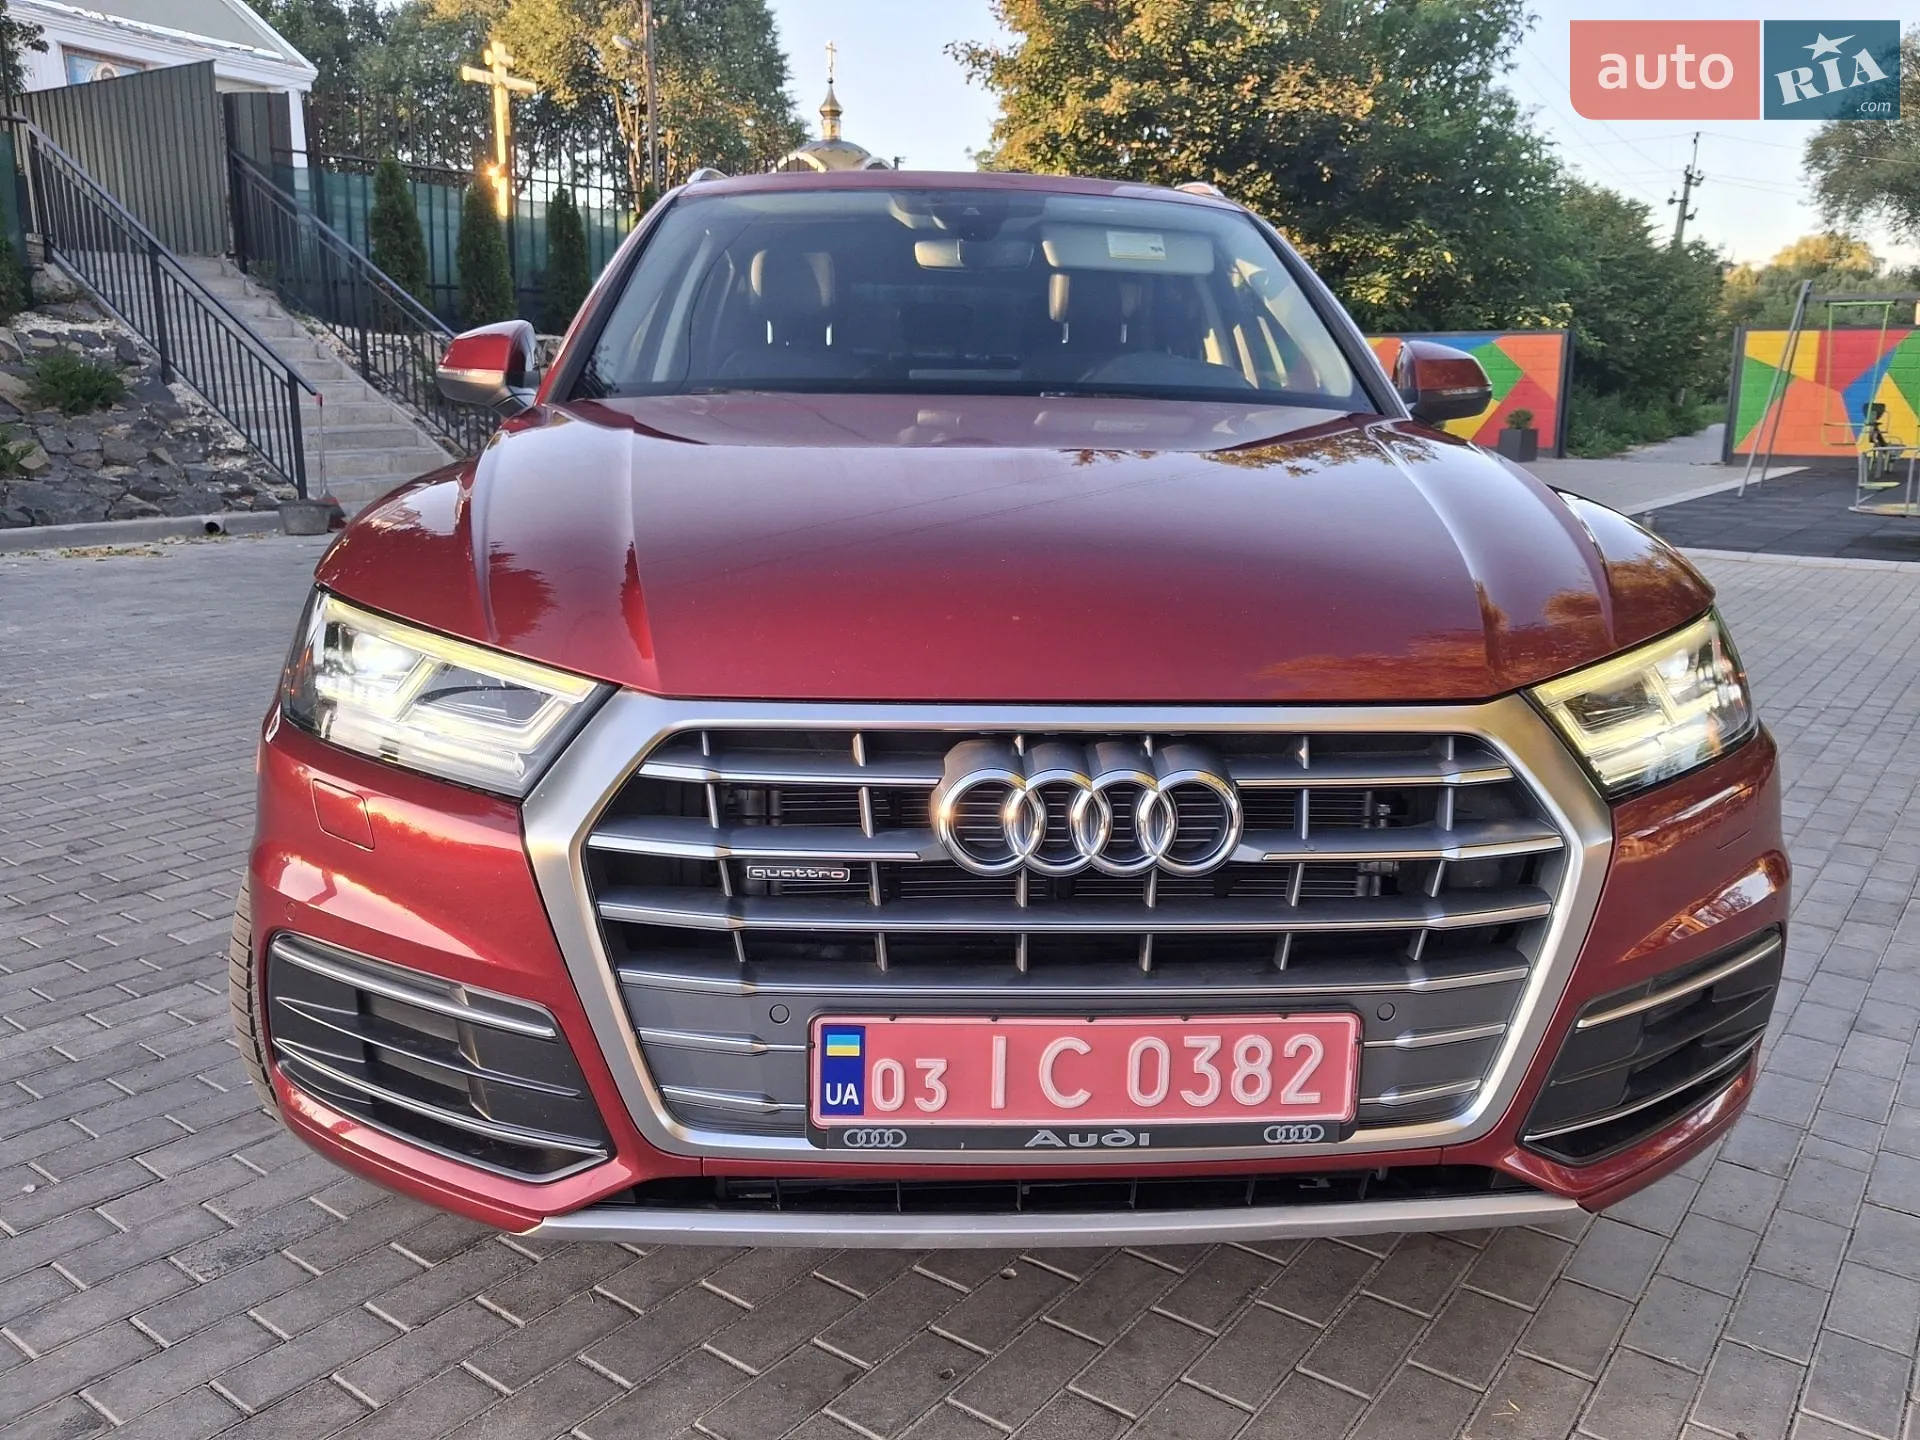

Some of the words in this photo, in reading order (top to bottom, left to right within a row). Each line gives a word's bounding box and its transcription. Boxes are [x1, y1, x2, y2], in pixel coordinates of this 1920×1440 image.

[751, 868, 845, 878] quattro
[871, 1058, 948, 1113] 03
[1126, 1033, 1324, 1107] 0382
[825, 1082, 860, 1106] UA
[1024, 1128, 1151, 1148] Audi
